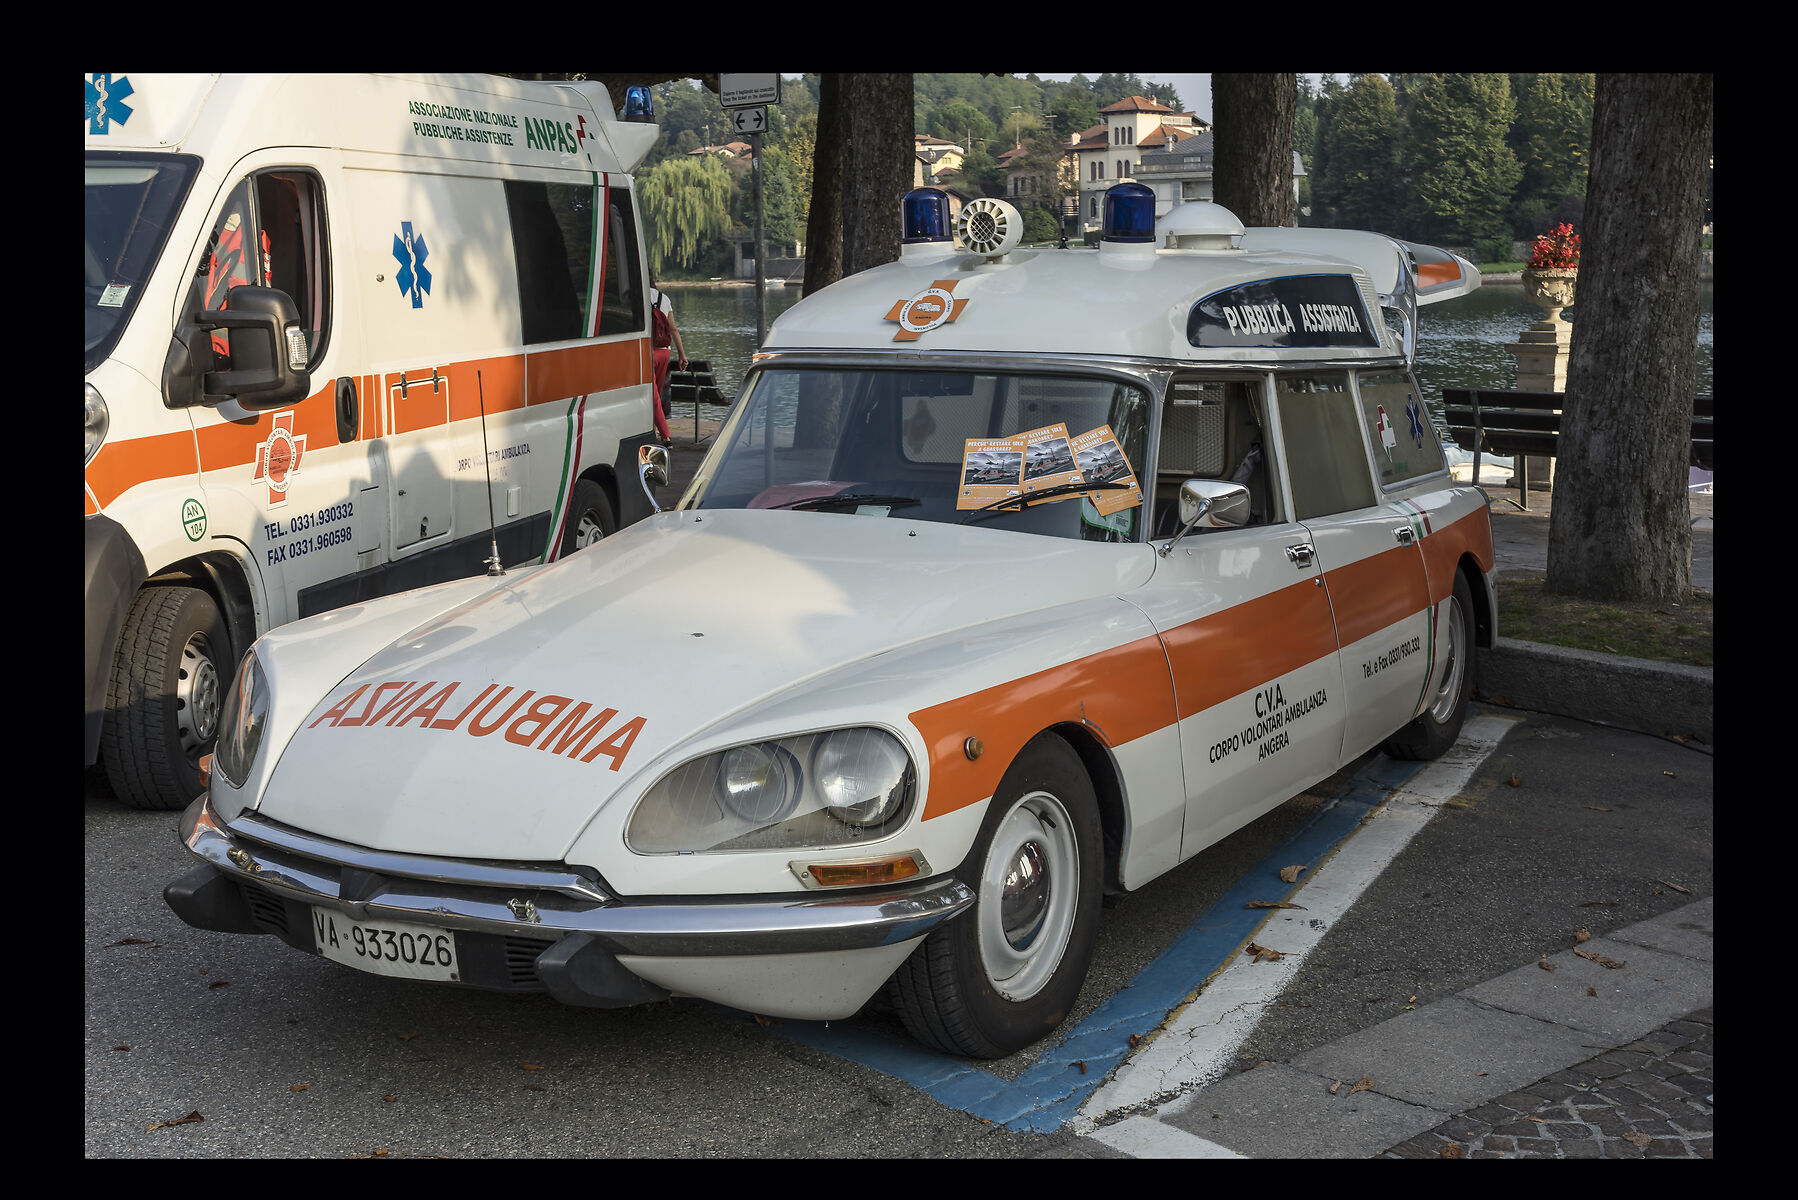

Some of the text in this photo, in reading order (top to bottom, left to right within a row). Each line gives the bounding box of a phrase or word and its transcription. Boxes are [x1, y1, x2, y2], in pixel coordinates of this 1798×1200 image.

[409, 101, 518, 128] ASSOCIAZIONE NAZIONALE
[413, 121, 514, 146] PUBBLICHE ASSISTENZE
[524, 116, 577, 154] ANPAS
[1223, 303, 1361, 336] PUBBLICA ASSISTENZA
[186, 505, 199, 518] AN
[264, 502, 353, 541] TEL. 0331.930332
[190, 523, 203, 536] 104
[267, 527, 352, 566] FAX 0331.960598
[1362, 659, 1374, 679] Tel.
[1374, 661, 1378, 674] e
[1378, 656, 1389, 671] Fax
[1255, 683, 1287, 718] C.V.A.
[1209, 688, 1328, 764] CORPO VOLONTARI AMBULANZA
[1258, 730, 1290, 761] ANGERA
[314, 911, 452, 967] VA 933026
